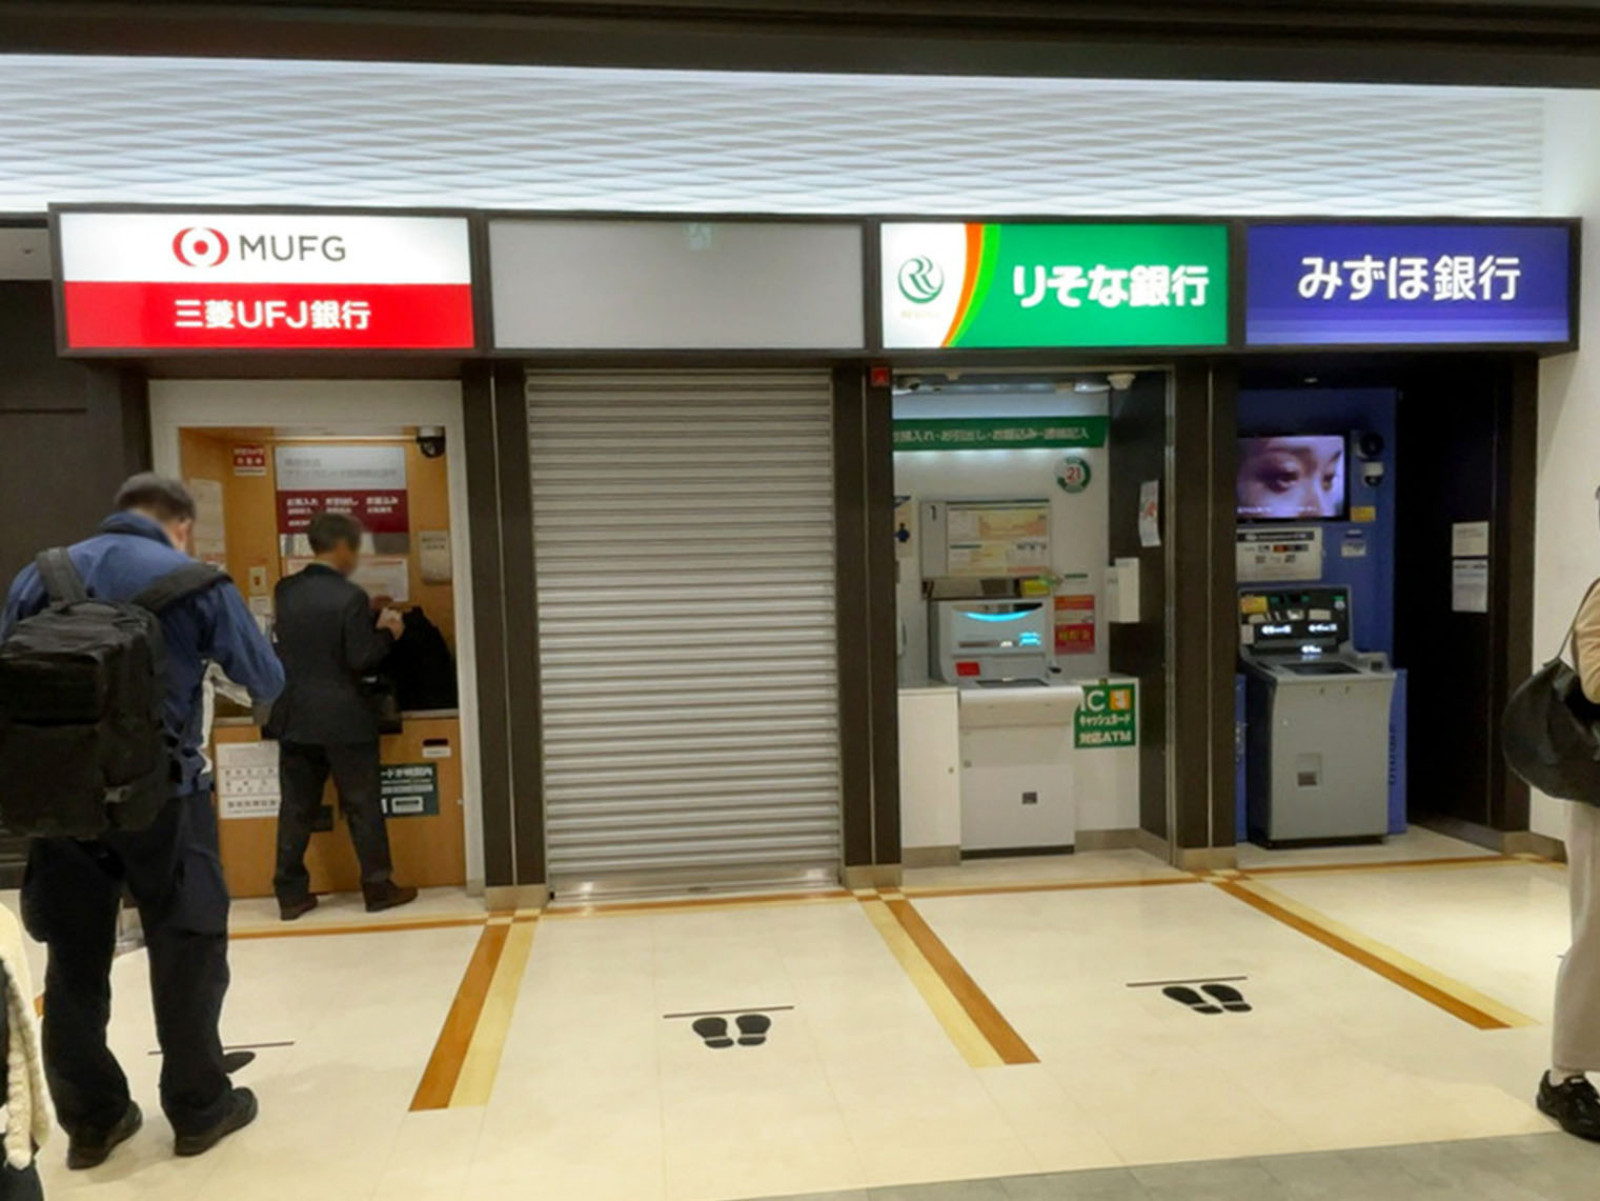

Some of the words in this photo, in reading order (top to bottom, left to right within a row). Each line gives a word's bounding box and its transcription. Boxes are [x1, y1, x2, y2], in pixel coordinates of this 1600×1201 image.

[239, 235, 346, 262] MUFG
[1013, 264, 1210, 308] りそな銀行
[1298, 254, 1521, 301] みずほ銀行
[174, 299, 371, 330] 三菱UFJ銀行
